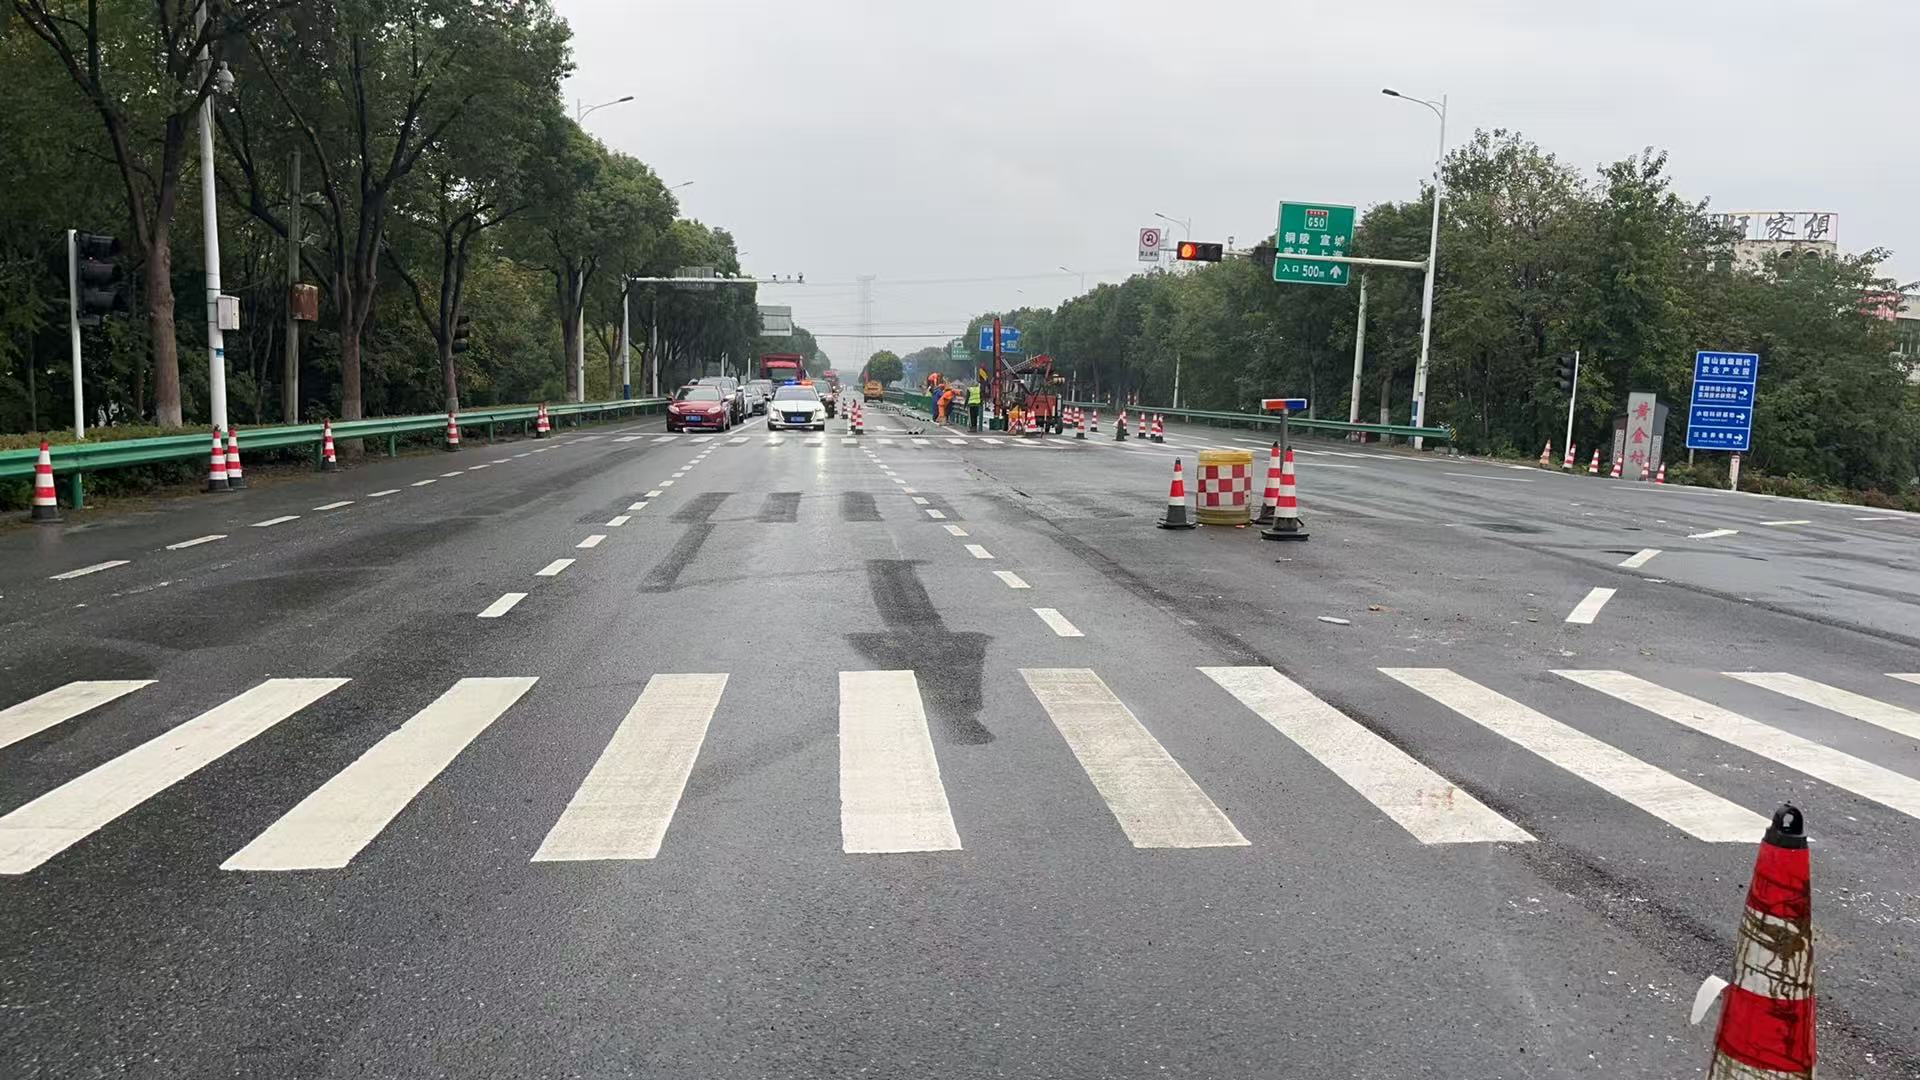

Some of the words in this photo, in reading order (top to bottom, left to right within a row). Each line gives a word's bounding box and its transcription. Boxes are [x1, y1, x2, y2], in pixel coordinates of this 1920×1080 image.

[1308, 217, 1325, 228] G50
[1285, 232, 1310, 245] 铜陵
[1282, 265, 1299, 273] 入口
[1630, 402, 1651, 465] 黄金村
